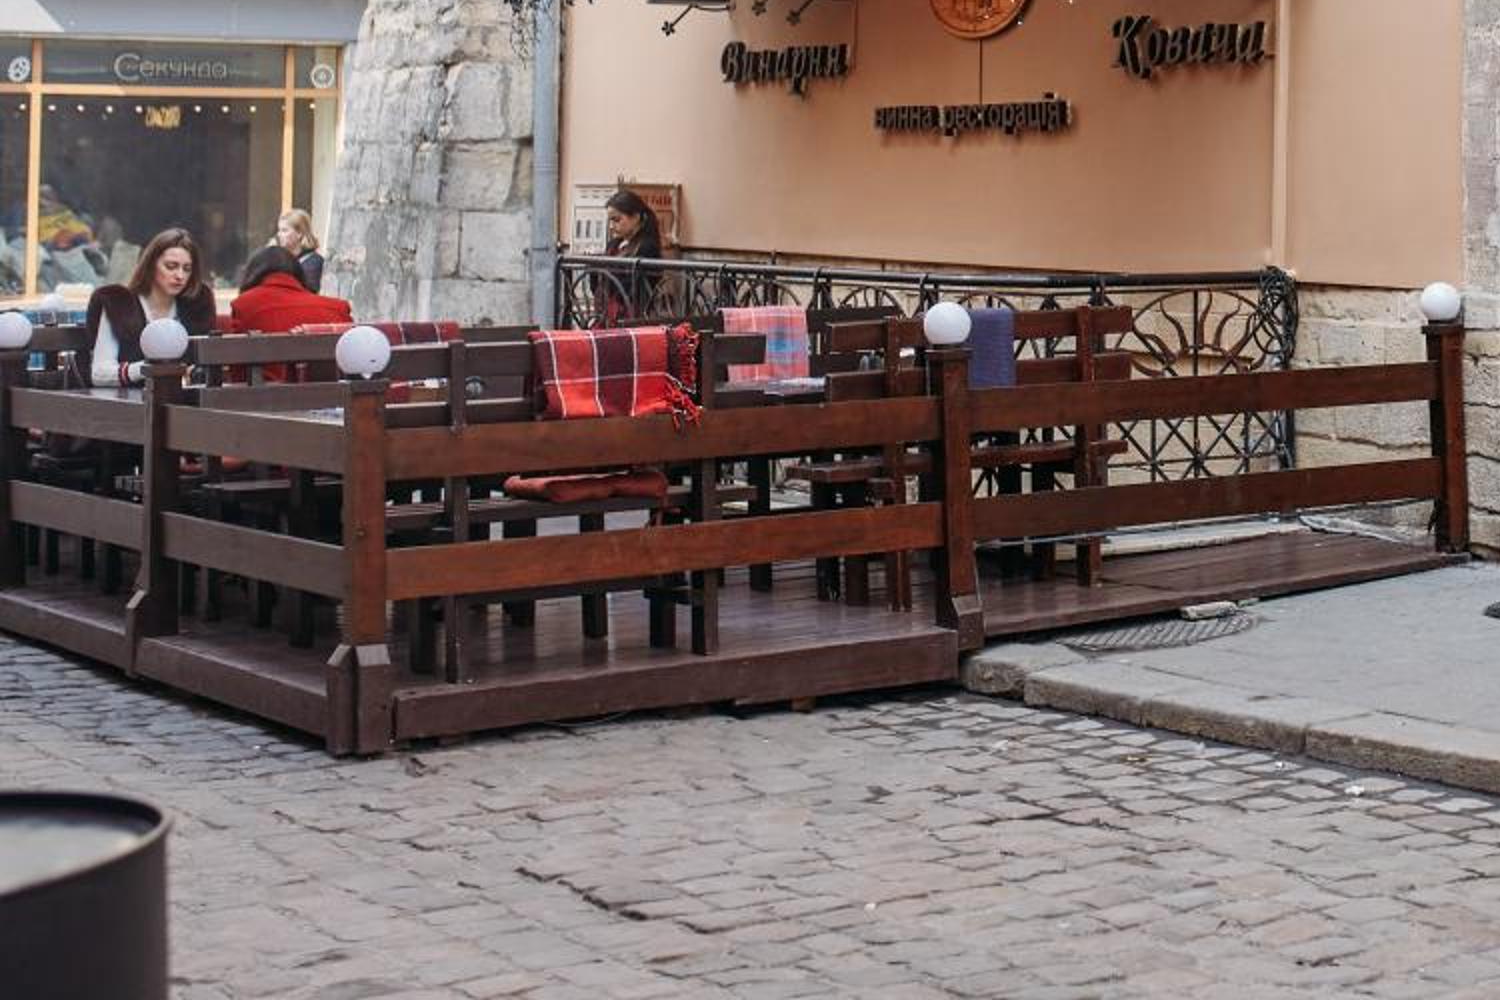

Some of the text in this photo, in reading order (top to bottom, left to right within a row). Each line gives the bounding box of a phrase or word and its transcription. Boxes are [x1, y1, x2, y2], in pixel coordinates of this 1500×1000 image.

[1112, 15, 1266, 79] Ковача
[874, 92, 1069, 137] винна ресторація
